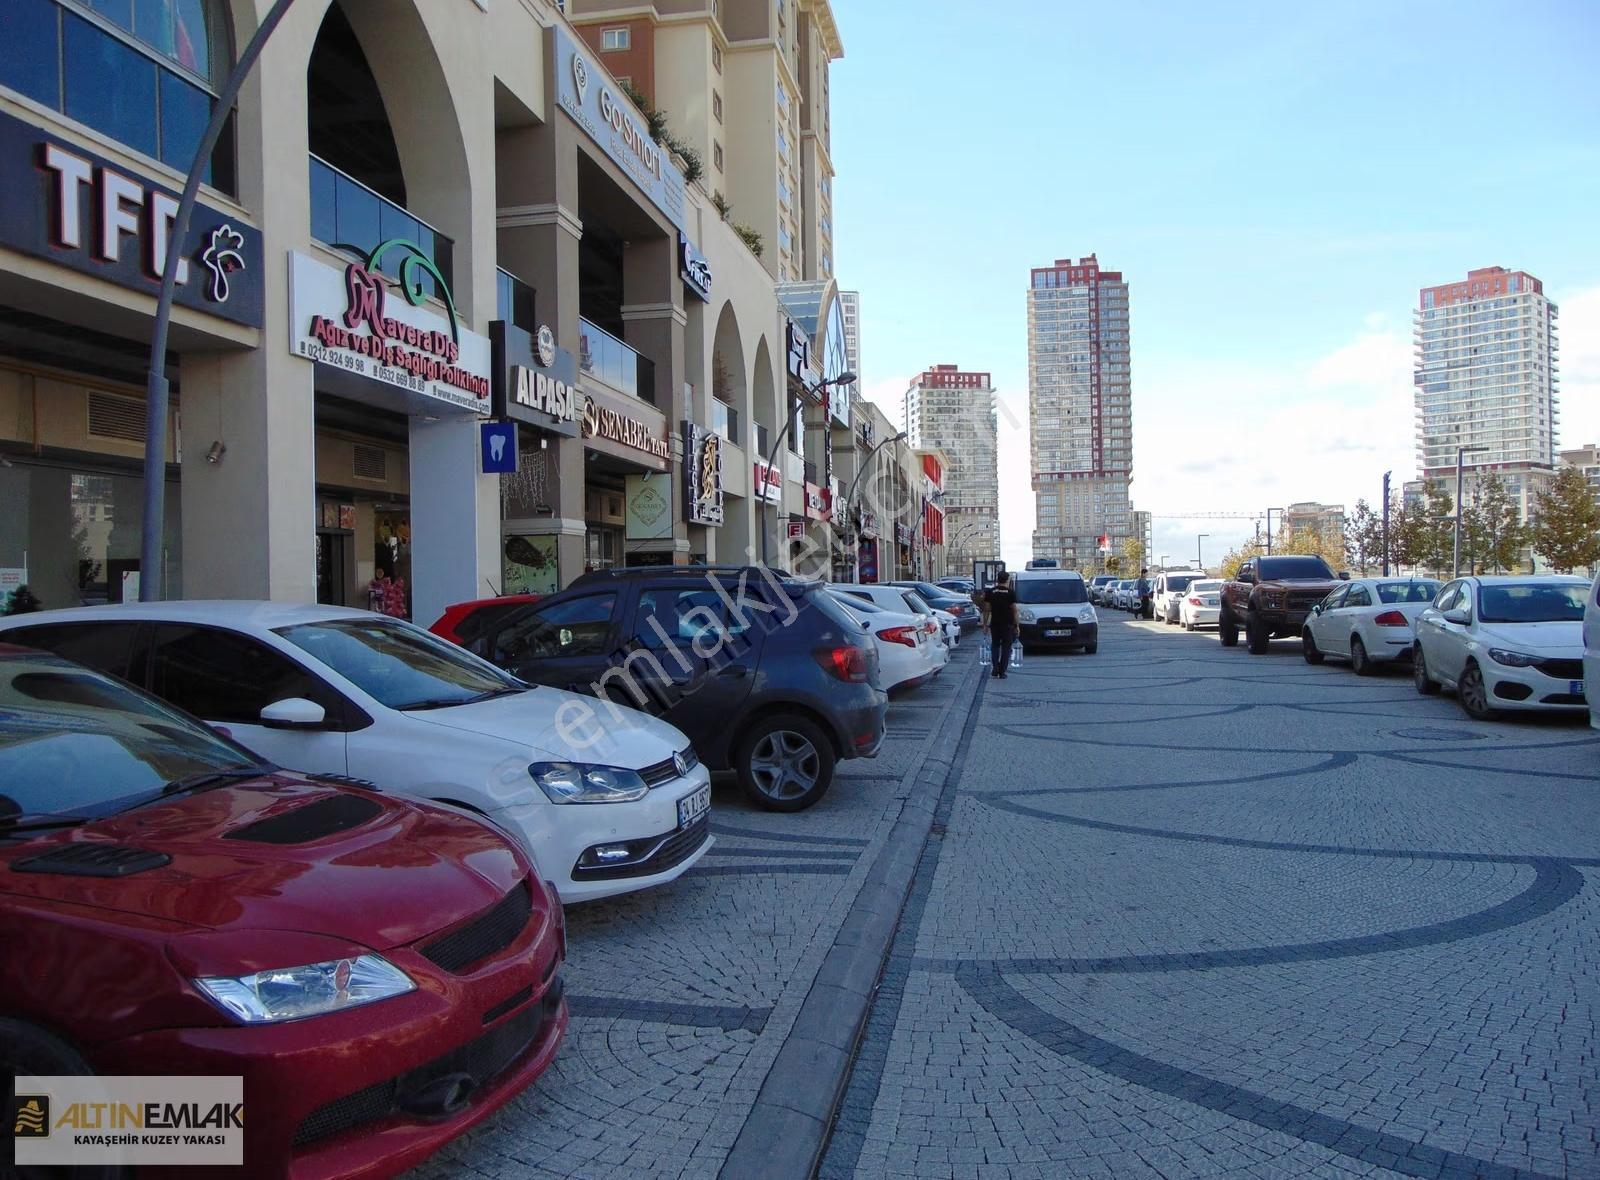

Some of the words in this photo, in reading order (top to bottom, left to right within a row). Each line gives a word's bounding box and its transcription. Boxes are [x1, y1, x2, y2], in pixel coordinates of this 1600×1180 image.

[311, 315, 350, 348] Ağız
[350, 334, 370, 353] ve
[307, 343, 328, 361] 0212
[329, 350, 343, 366] 924
[344, 355, 354, 369] 99
[379, 367, 395, 384] 0532
[515, 365, 576, 424] ALPAŞA
